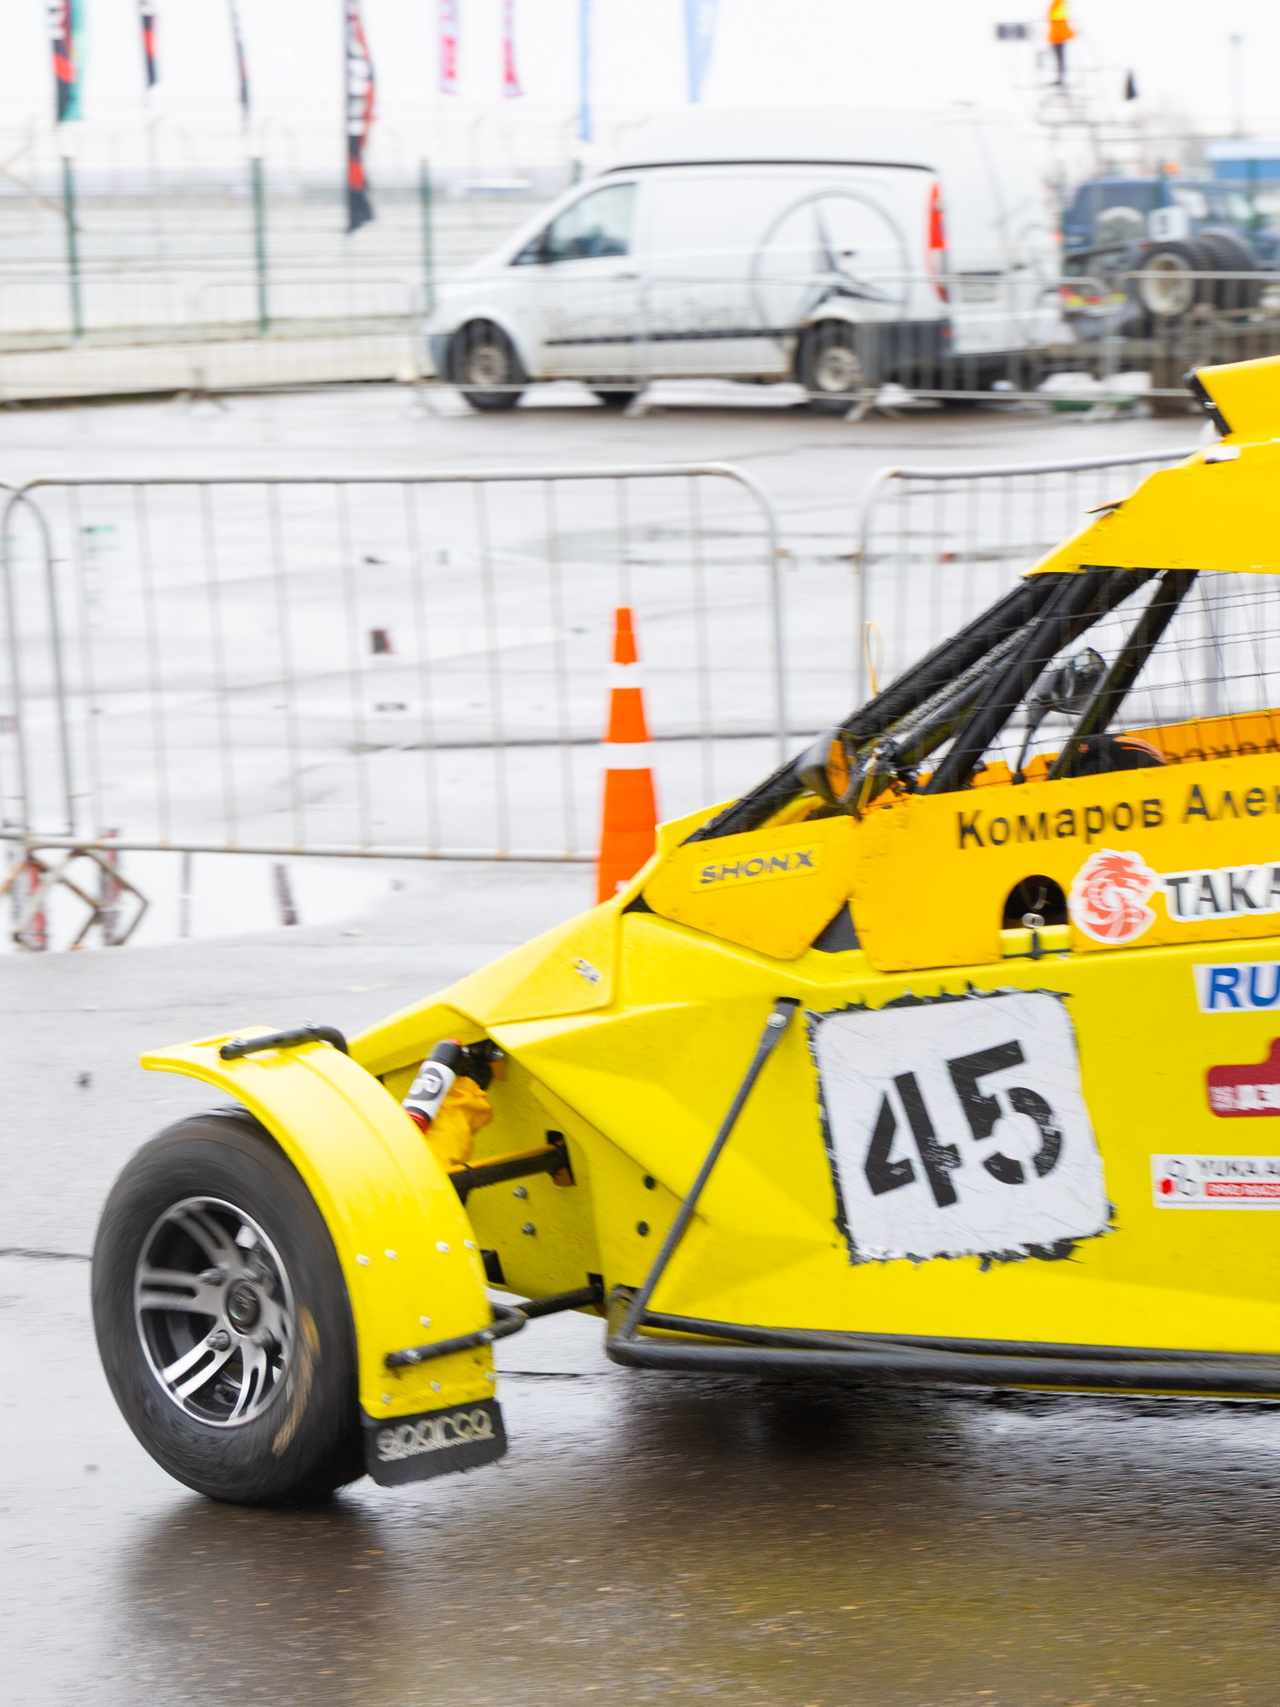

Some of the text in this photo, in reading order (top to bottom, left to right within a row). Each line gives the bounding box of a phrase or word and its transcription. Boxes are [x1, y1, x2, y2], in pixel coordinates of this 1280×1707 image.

[957, 795, 1163, 850] Комаров
[700, 850, 813, 884] SHONX
[864, 1040, 1063, 1208] 45
[376, 1408, 495, 1460] sparco
